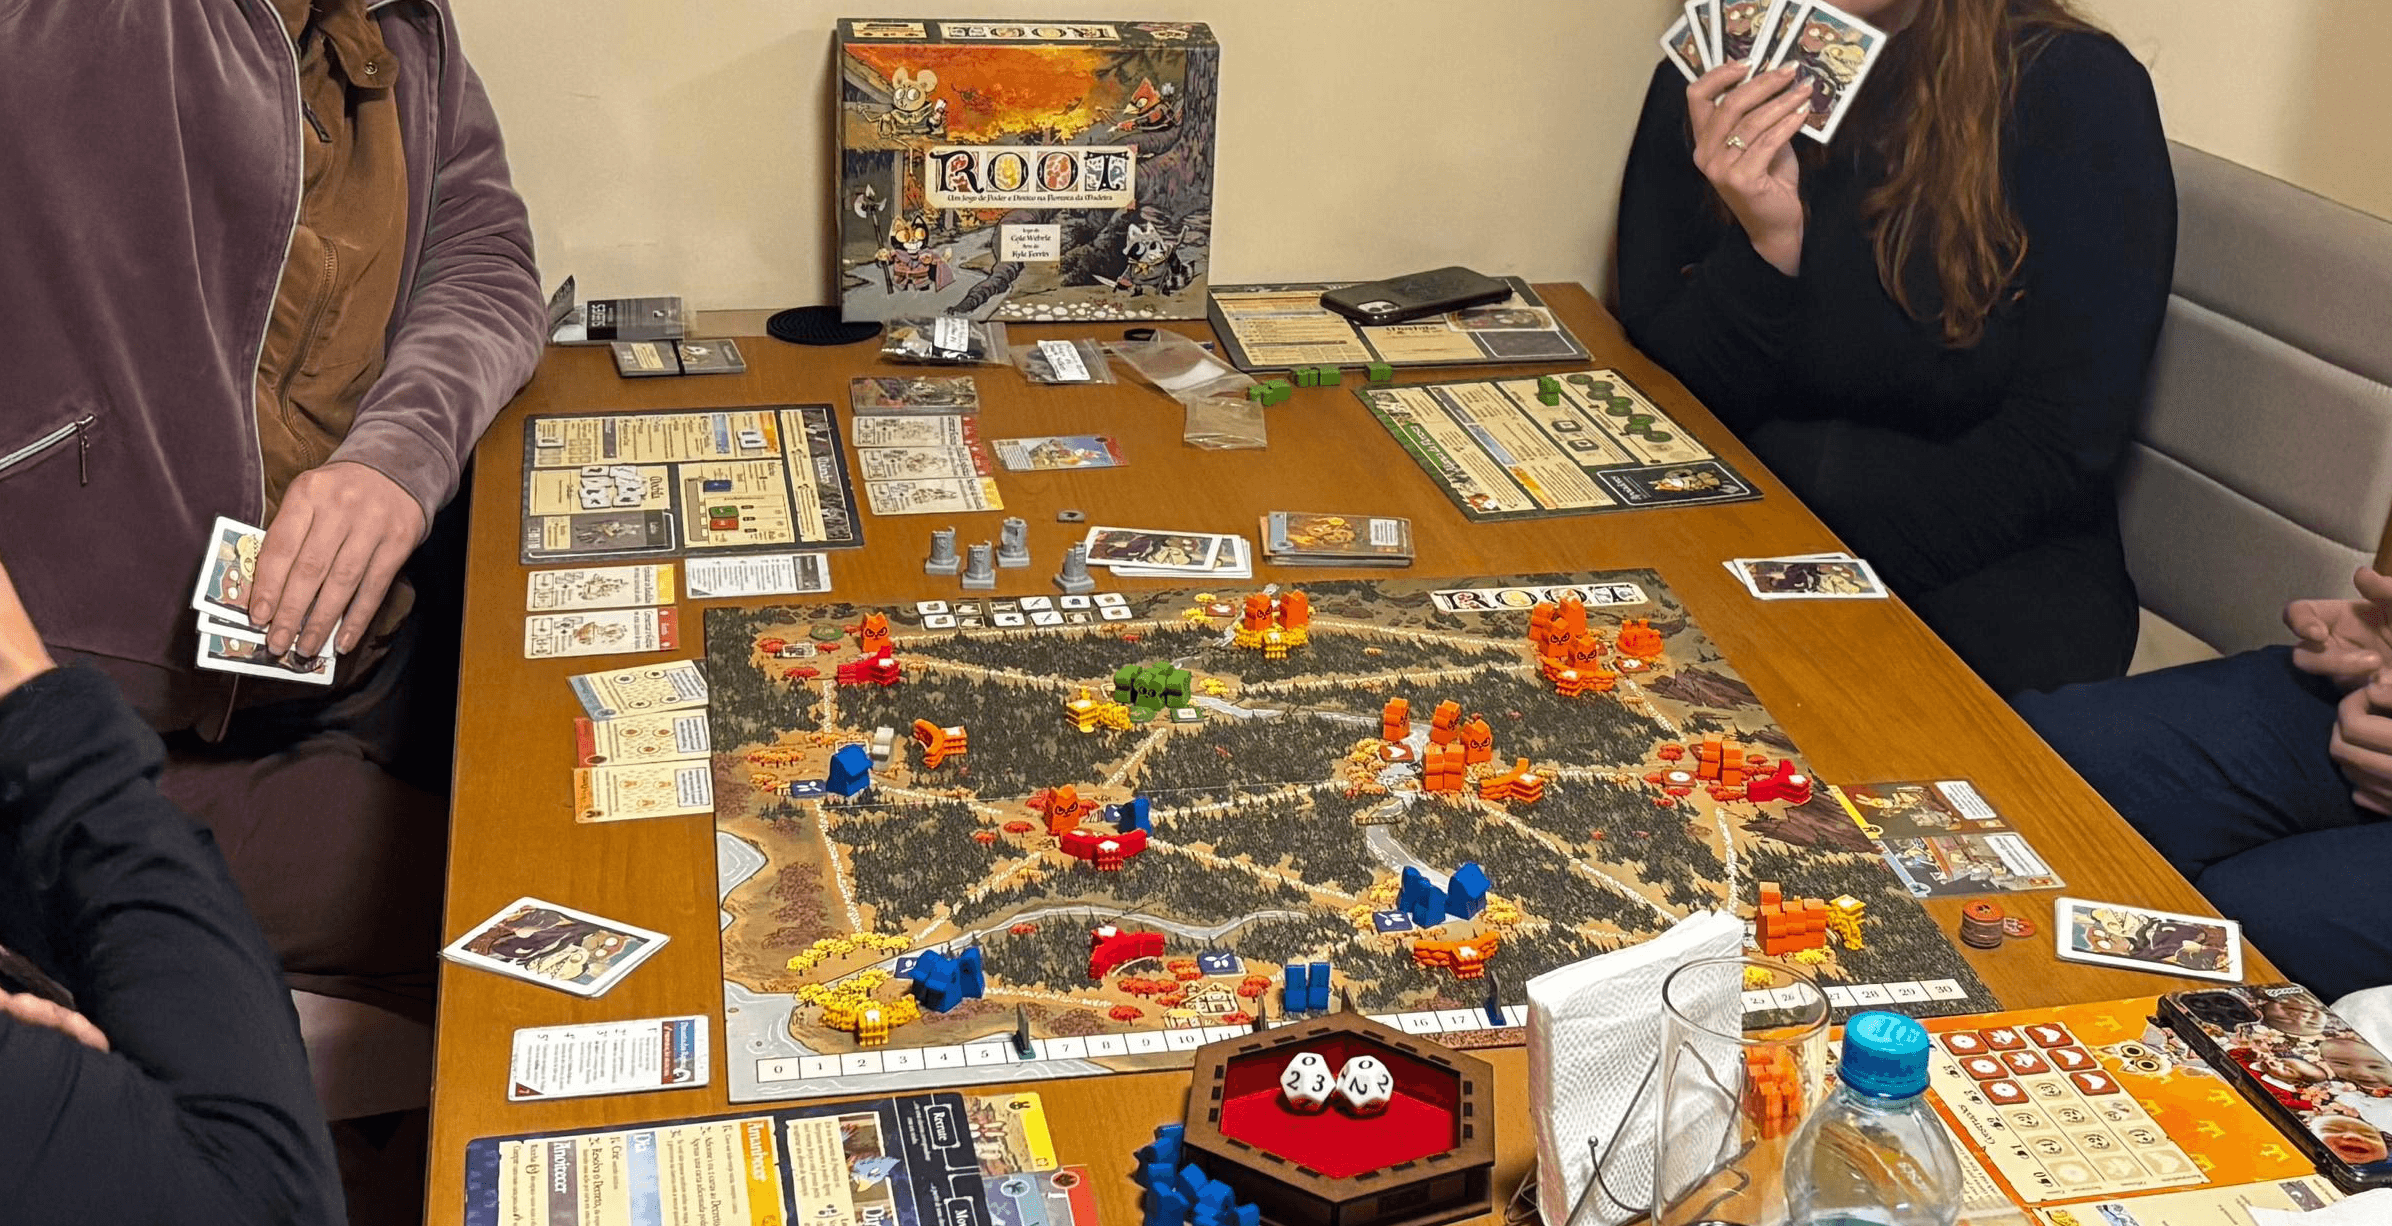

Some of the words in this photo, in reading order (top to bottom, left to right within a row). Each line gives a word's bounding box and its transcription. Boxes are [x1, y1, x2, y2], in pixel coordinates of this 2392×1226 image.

[929, 150, 1129, 193] ROOT
[774, 1065, 783, 1074] 0
[857, 1059, 866, 1068] 2
[899, 1055, 908, 1064] 3
[939, 1052, 948, 1061] 4
[980, 1049, 989, 1058] 5
[1062, 1044, 1070, 1052] 7
[1141, 1038, 1151, 1047] 9
[1178, 1035, 1195, 1044] 10
[1412, 1018, 1429, 1028] 16
[1451, 1015, 1466, 1024] 17
[1862, 989, 1879, 999] 28
[1901, 987, 1916, 997] 29
[1936, 985, 1953, 995] 30
[1302, 1056, 1316, 1066] 0
[1358, 1060, 1373, 1069] 0
[1286, 1071, 1300, 1090] 2
[1312, 1074, 1325, 1092] 3
[1349, 1077, 1367, 1095] 2
[1377, 1074, 1389, 1094] 2
[933, 1112, 947, 1141] Recrute
[634, 1133, 651, 1153] Dia
[747, 1122, 769, 1182] Amanhecer
[554, 1142, 571, 1194] Anoitecer
